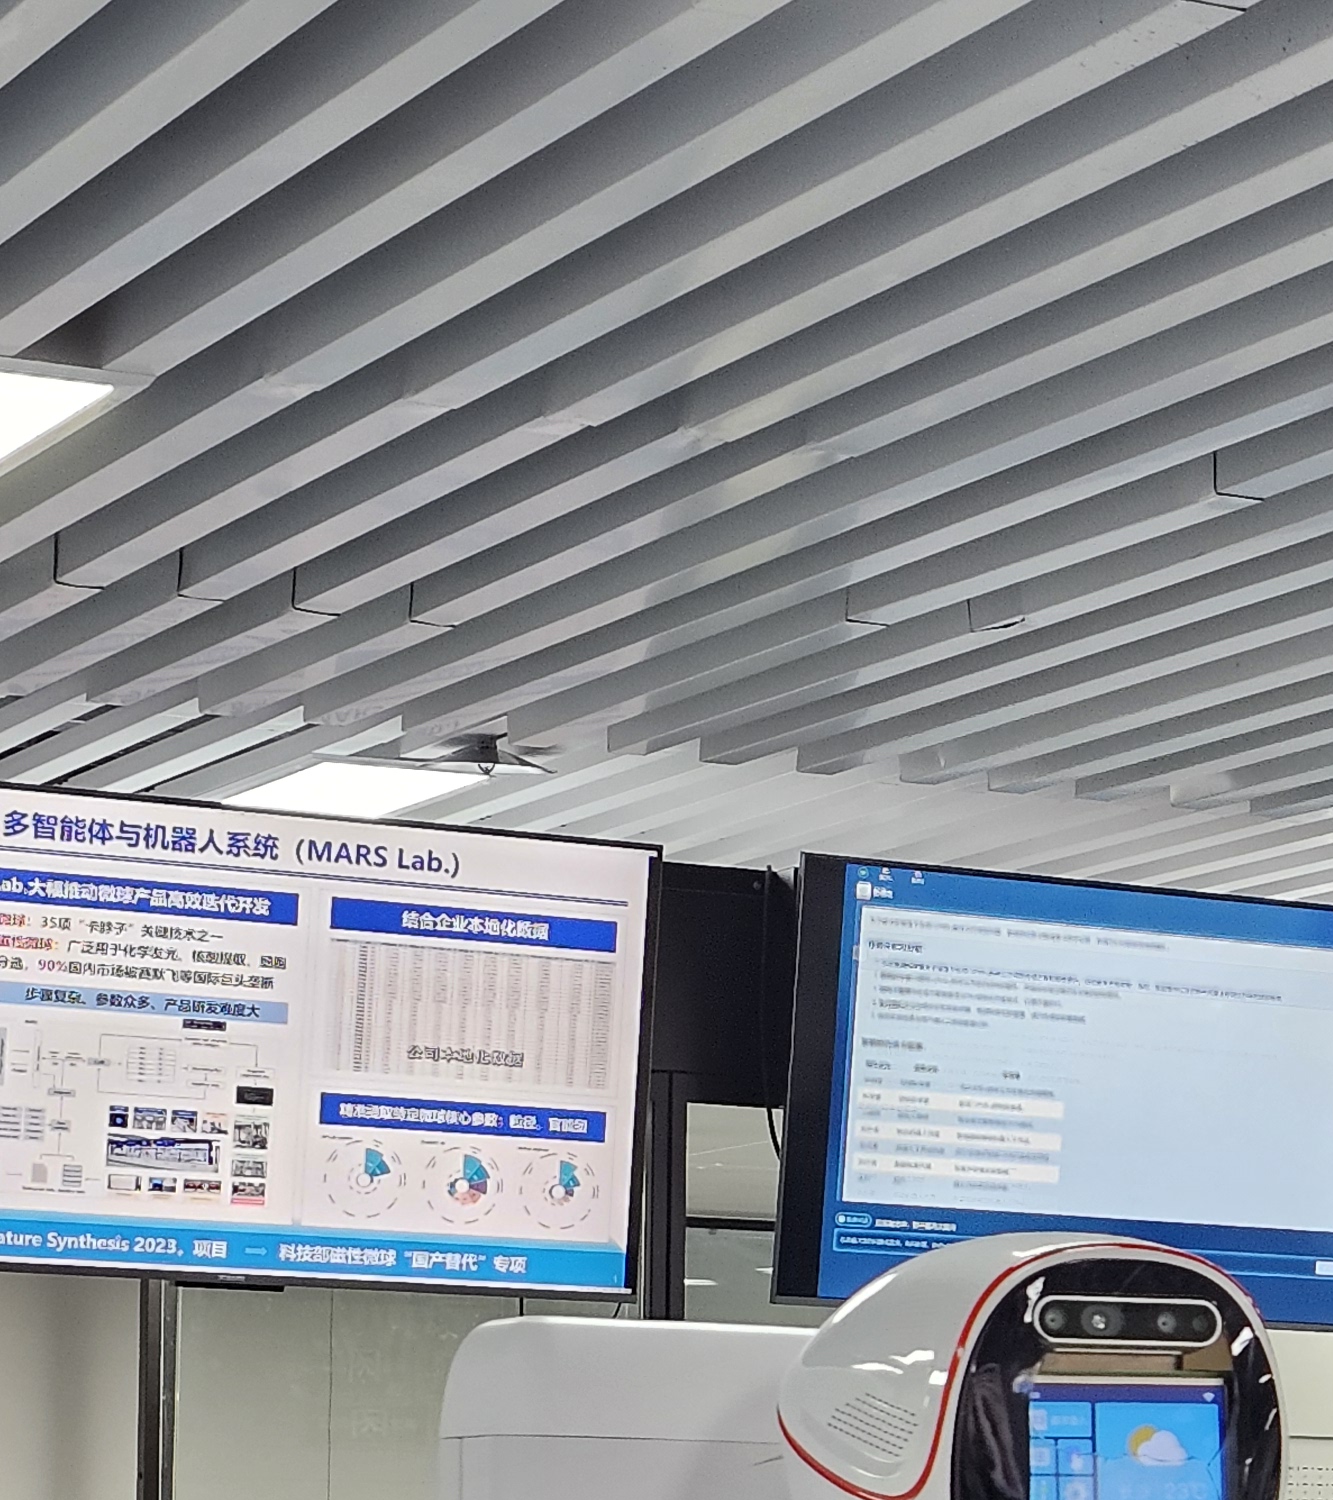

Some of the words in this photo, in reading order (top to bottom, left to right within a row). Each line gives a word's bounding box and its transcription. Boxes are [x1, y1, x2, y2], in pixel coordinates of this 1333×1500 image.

[3, 810, 280, 861] 多智能体与机器人系统
[398, 848, 460, 878] Lab.)
[0, 1230, 43, 1249] ature
[47, 1232, 130, 1252] Synthesis
